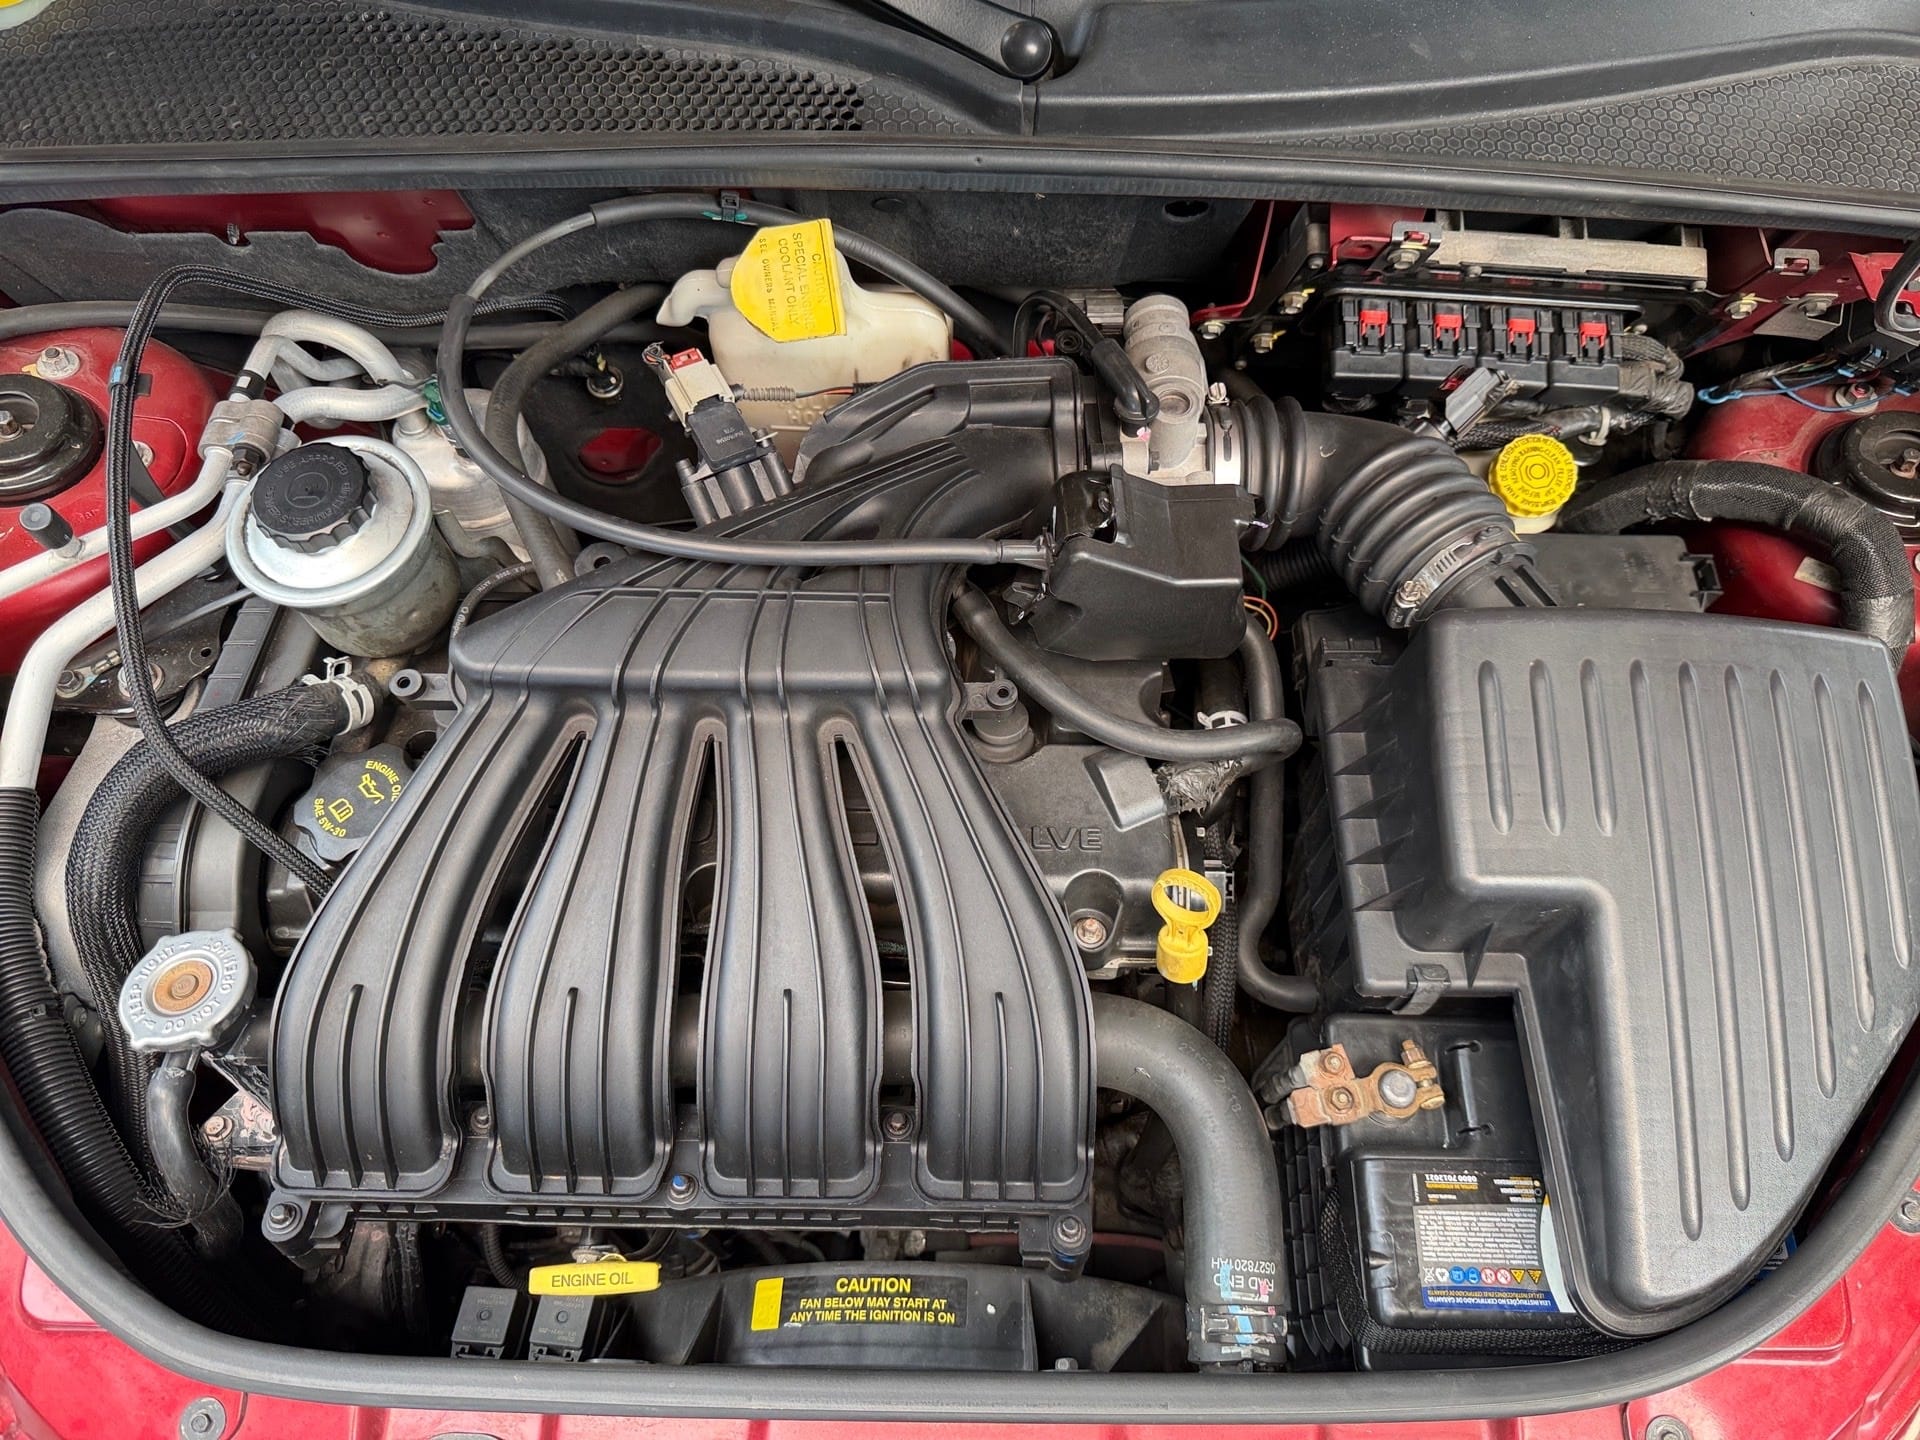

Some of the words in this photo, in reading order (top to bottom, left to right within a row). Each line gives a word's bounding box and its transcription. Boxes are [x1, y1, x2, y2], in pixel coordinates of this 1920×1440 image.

[759, 238, 768, 254] SEE
[778, 238, 796, 293] COOLANT
[792, 232, 806, 281] SPECIAL
[799, 284, 816, 330] ENGINE
[786, 296, 802, 325] ONLY
[365, 760, 400, 785] ENGINE
[390, 784, 403, 802] OIL
[313, 798, 325, 817] SAE
[318, 818, 346, 838] 5W-30
[129, 984, 147, 1022] KEEP
[138, 943, 176, 980] TIGHT
[162, 1018, 186, 1034] DO
[192, 996, 221, 1024] NOT
[220, 956, 238, 994] OPEN
[1424, 1174, 1457, 1182] 7012021
[1458, 1174, 1478, 1182] 0800
[1211, 1256, 1275, 1275] 05278201AH
[552, 1273, 605, 1287] ENGINE
[609, 1272, 634, 1285] OIL
[836, 1277, 911, 1293] CAUTION
[1248, 1278, 1274, 1292] RAD
[800, 1299, 821, 1309] FAN
[824, 1297, 863, 1308] BELOW
[867, 1298, 891, 1307] MAY
[893, 1298, 930, 1309] START
[932, 1299, 947, 1310] AT
[790, 1312, 812, 1322] ANY
[815, 1311, 841, 1321] TIME
[844, 1310, 866, 1320] THE
[870, 1310, 920, 1321] IGNITION
[924, 1312, 934, 1322] IS
[938, 1312, 955, 1324] ON
